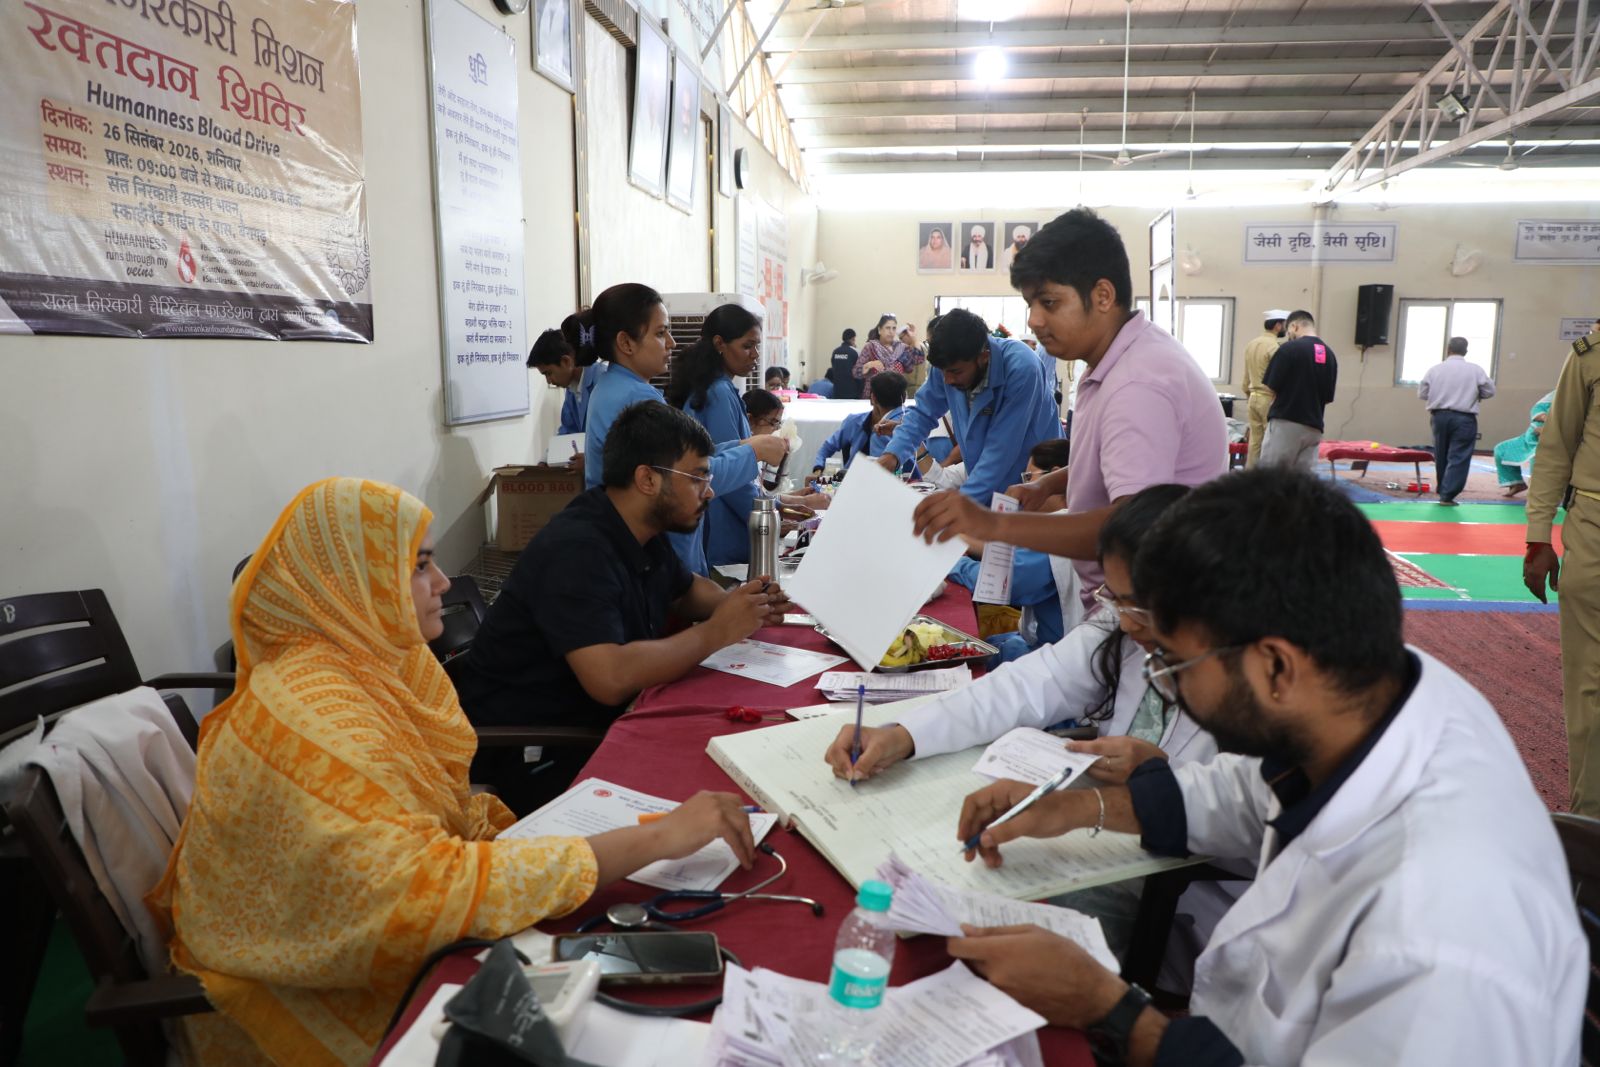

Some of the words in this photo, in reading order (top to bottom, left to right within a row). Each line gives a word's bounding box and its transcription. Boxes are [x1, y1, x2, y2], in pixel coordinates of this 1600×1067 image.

[24, 1, 200, 101] रक्तदान
[217, 65, 306, 137] शिविर
[251, 18, 326, 93] मिशन
[87, 80, 195, 133] Humanness
[198, 115, 242, 146] Blood
[245, 131, 281, 157] Drive
[41, 99, 93, 135] दिनांक:
[103, 122, 121, 141] 26
[124, 122, 165, 153] सितंबर
[168, 140, 204, 165] 2026,
[206, 148, 242, 172] शनिवार
[44, 133, 87, 160] समय:
[137, 158, 177, 179] 09:00
[180, 163, 199, 183] बजे
[201, 168, 211, 187] से
[213, 175, 234, 193] शाम
[46, 162, 90, 188] स्थान:
[106, 171, 129, 195] संत
[104, 229, 168, 252] HUMANNESS
[1253, 232, 1282, 248] जैसी
[1322, 232, 1348, 248] वैसी
[106, 251, 124, 261] runs
[125, 251, 156, 266] through
[156, 257, 169, 269] my
[126, 264, 155, 278] veins
[86, 290, 142, 314] निरंकारी
[204, 300, 254, 320] फाउंडेशन
[502, 483, 545, 492] BLOOD
[550, 483, 575, 492] BAG
